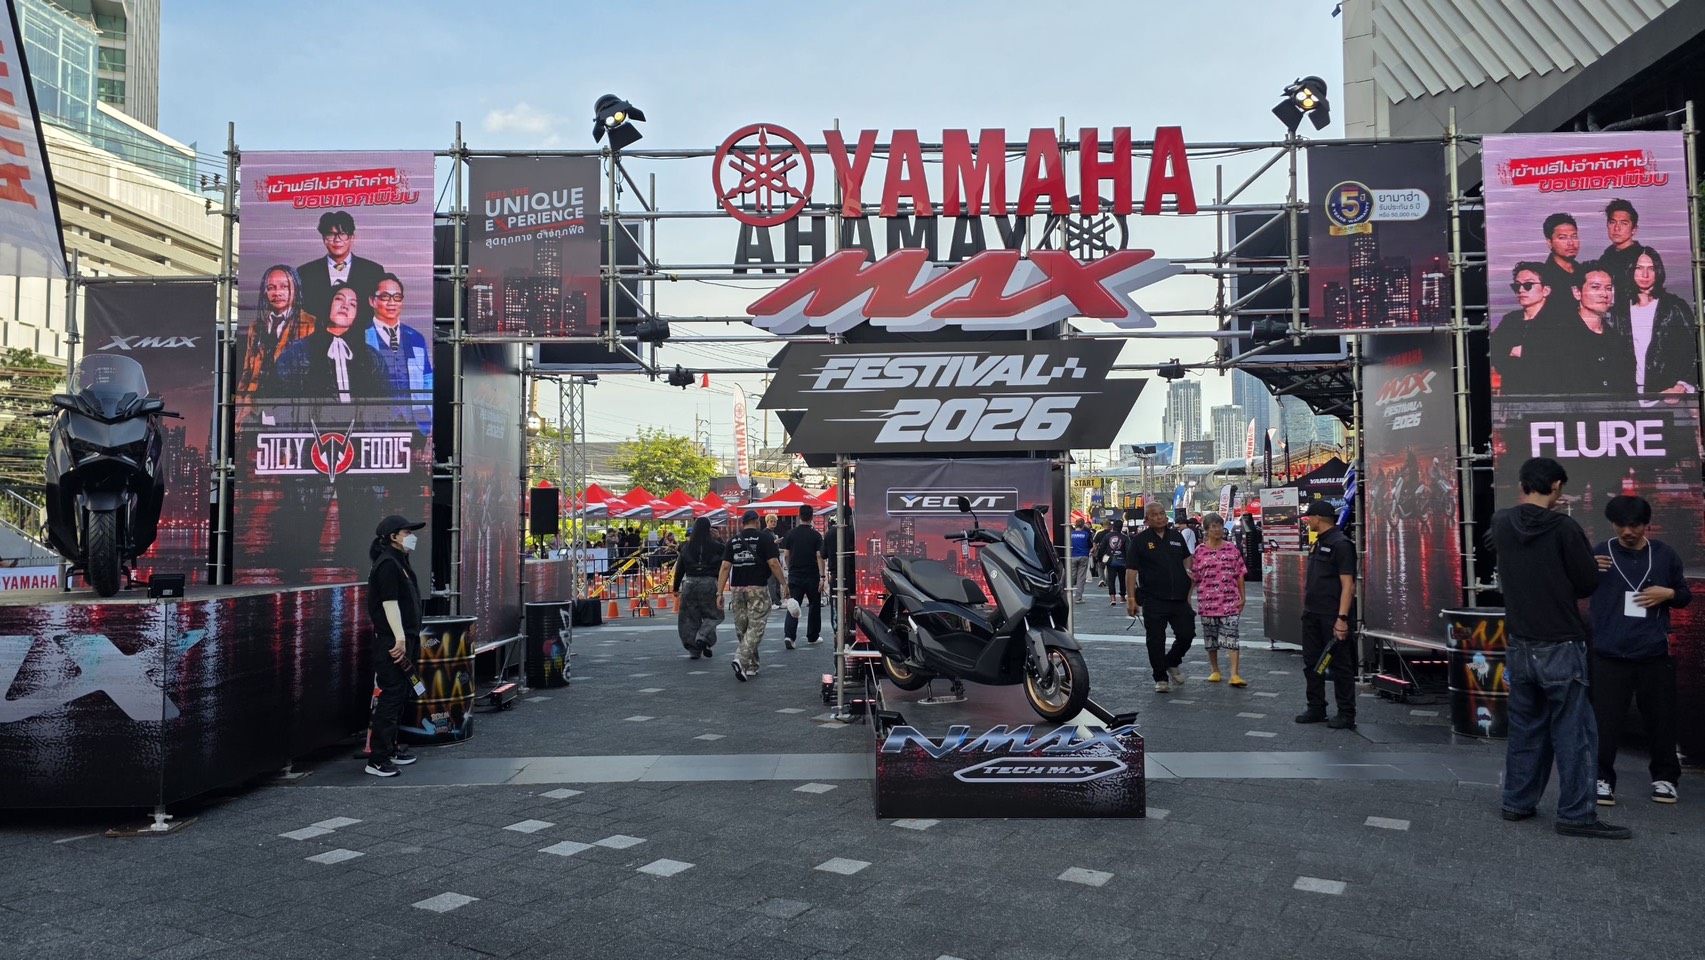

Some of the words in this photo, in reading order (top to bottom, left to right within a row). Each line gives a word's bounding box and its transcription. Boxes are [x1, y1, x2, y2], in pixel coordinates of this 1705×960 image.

[823, 125, 1197, 218] YAMAHA
[1511, 155, 1648, 178] เข้าฟรีไม่จำกัดค่าย
[268, 173, 401, 194] เข้าฟรีไม่จำกัดค่าย
[1538, 170, 1669, 193] ของแจกเพียบ
[293, 188, 420, 209] ของแจกเพียบ
[485, 187, 584, 218] UNIQUE
[1341, 191, 1360, 219] 5
[1378, 192, 1421, 203] ยามาฮ่า
[1378, 203, 1408, 211] รับประกัน
[485, 207, 584, 232] EXPERIENCE
[746, 248, 1182, 332] MAX
[811, 354, 1060, 391] FESTIVAL
[1376, 369, 1437, 406] MAX
[875, 396, 1082, 444] 2026
[1383, 401, 1419, 417] FESTIVAL
[1391, 413, 1422, 430] 2026
[1529, 419, 1667, 459] FLURE
[256, 433, 305, 470] SILLY
[360, 435, 412, 472] FOOLS
[1073, 479, 1095, 487] START
[3, 574, 58, 590] YAMAHA
[880, 724, 1142, 759] NMAX
[982, 765, 1045, 775] TECH
[1054, 765, 1098, 775] MAX
